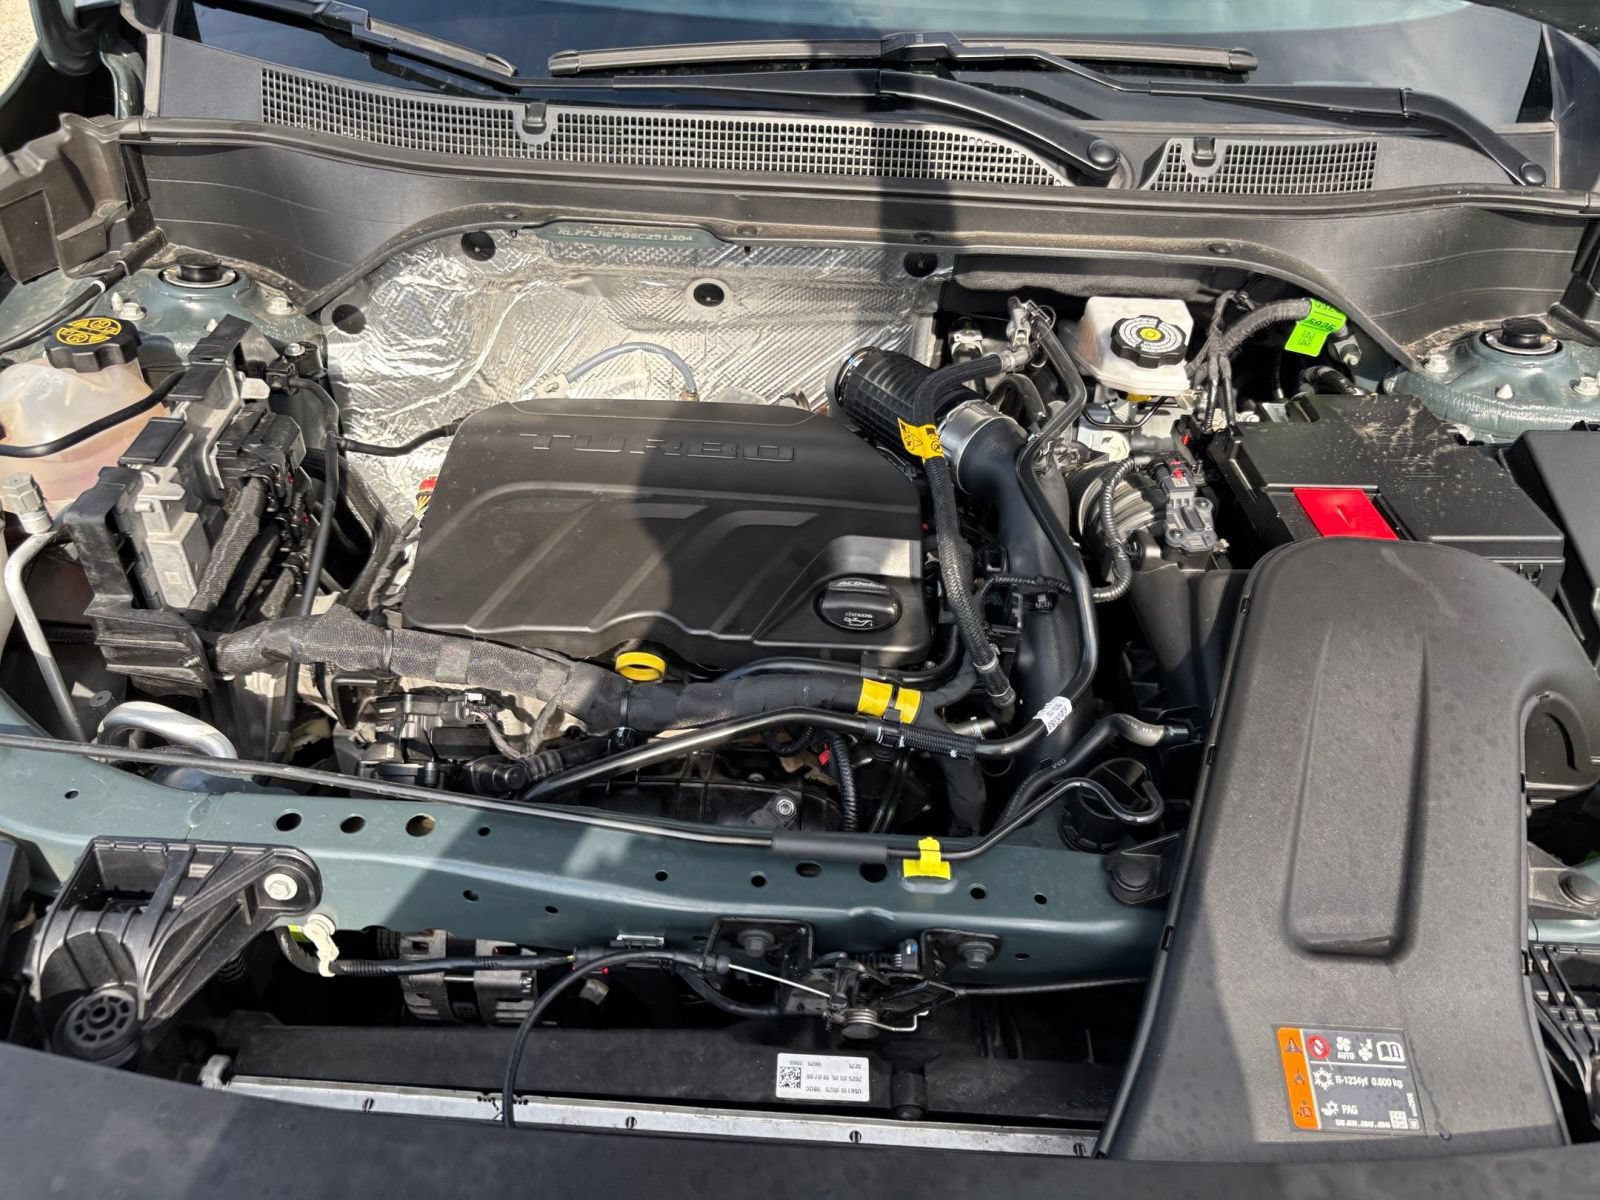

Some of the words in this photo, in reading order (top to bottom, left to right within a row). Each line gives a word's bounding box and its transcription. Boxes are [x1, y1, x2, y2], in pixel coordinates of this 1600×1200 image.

[519, 433, 795, 462] TURBO
[1337, 1052, 1355, 1060] AUTO
[1335, 1076, 1369, 1088] R-1234yf
[1392, 1078, 1404, 1089] kg
[1341, 1104, 1359, 1115] PAG
